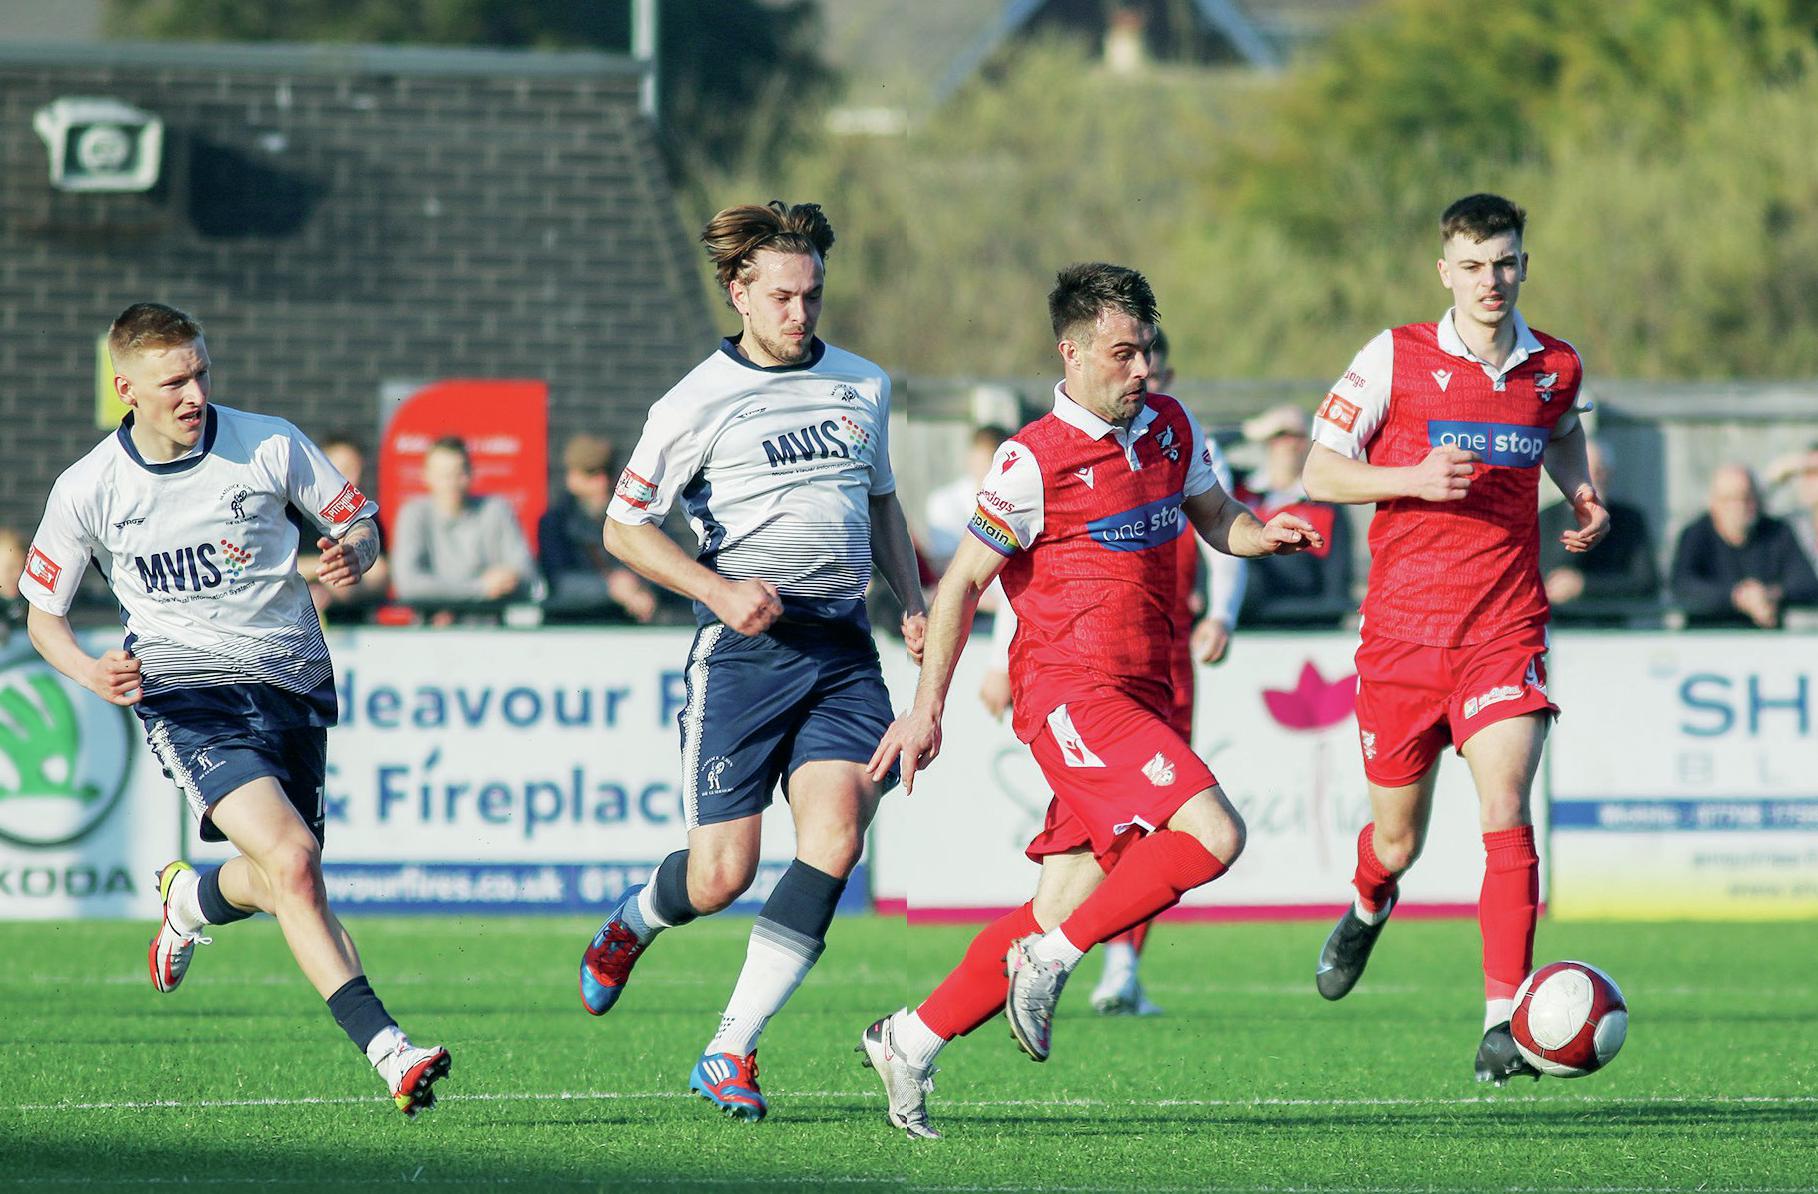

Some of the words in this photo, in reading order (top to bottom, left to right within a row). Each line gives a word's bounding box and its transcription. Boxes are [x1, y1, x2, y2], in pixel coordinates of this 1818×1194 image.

[762, 420, 849, 467] MVIS
[1440, 431, 1486, 450] one
[1495, 431, 1543, 460] stop
[1103, 520, 1145, 541] one
[1150, 504, 1181, 531] sto
[135, 543, 222, 593] MVIS
[1678, 672, 1811, 738] SH
[322, 866, 564, 903] vourfires.co.uk
